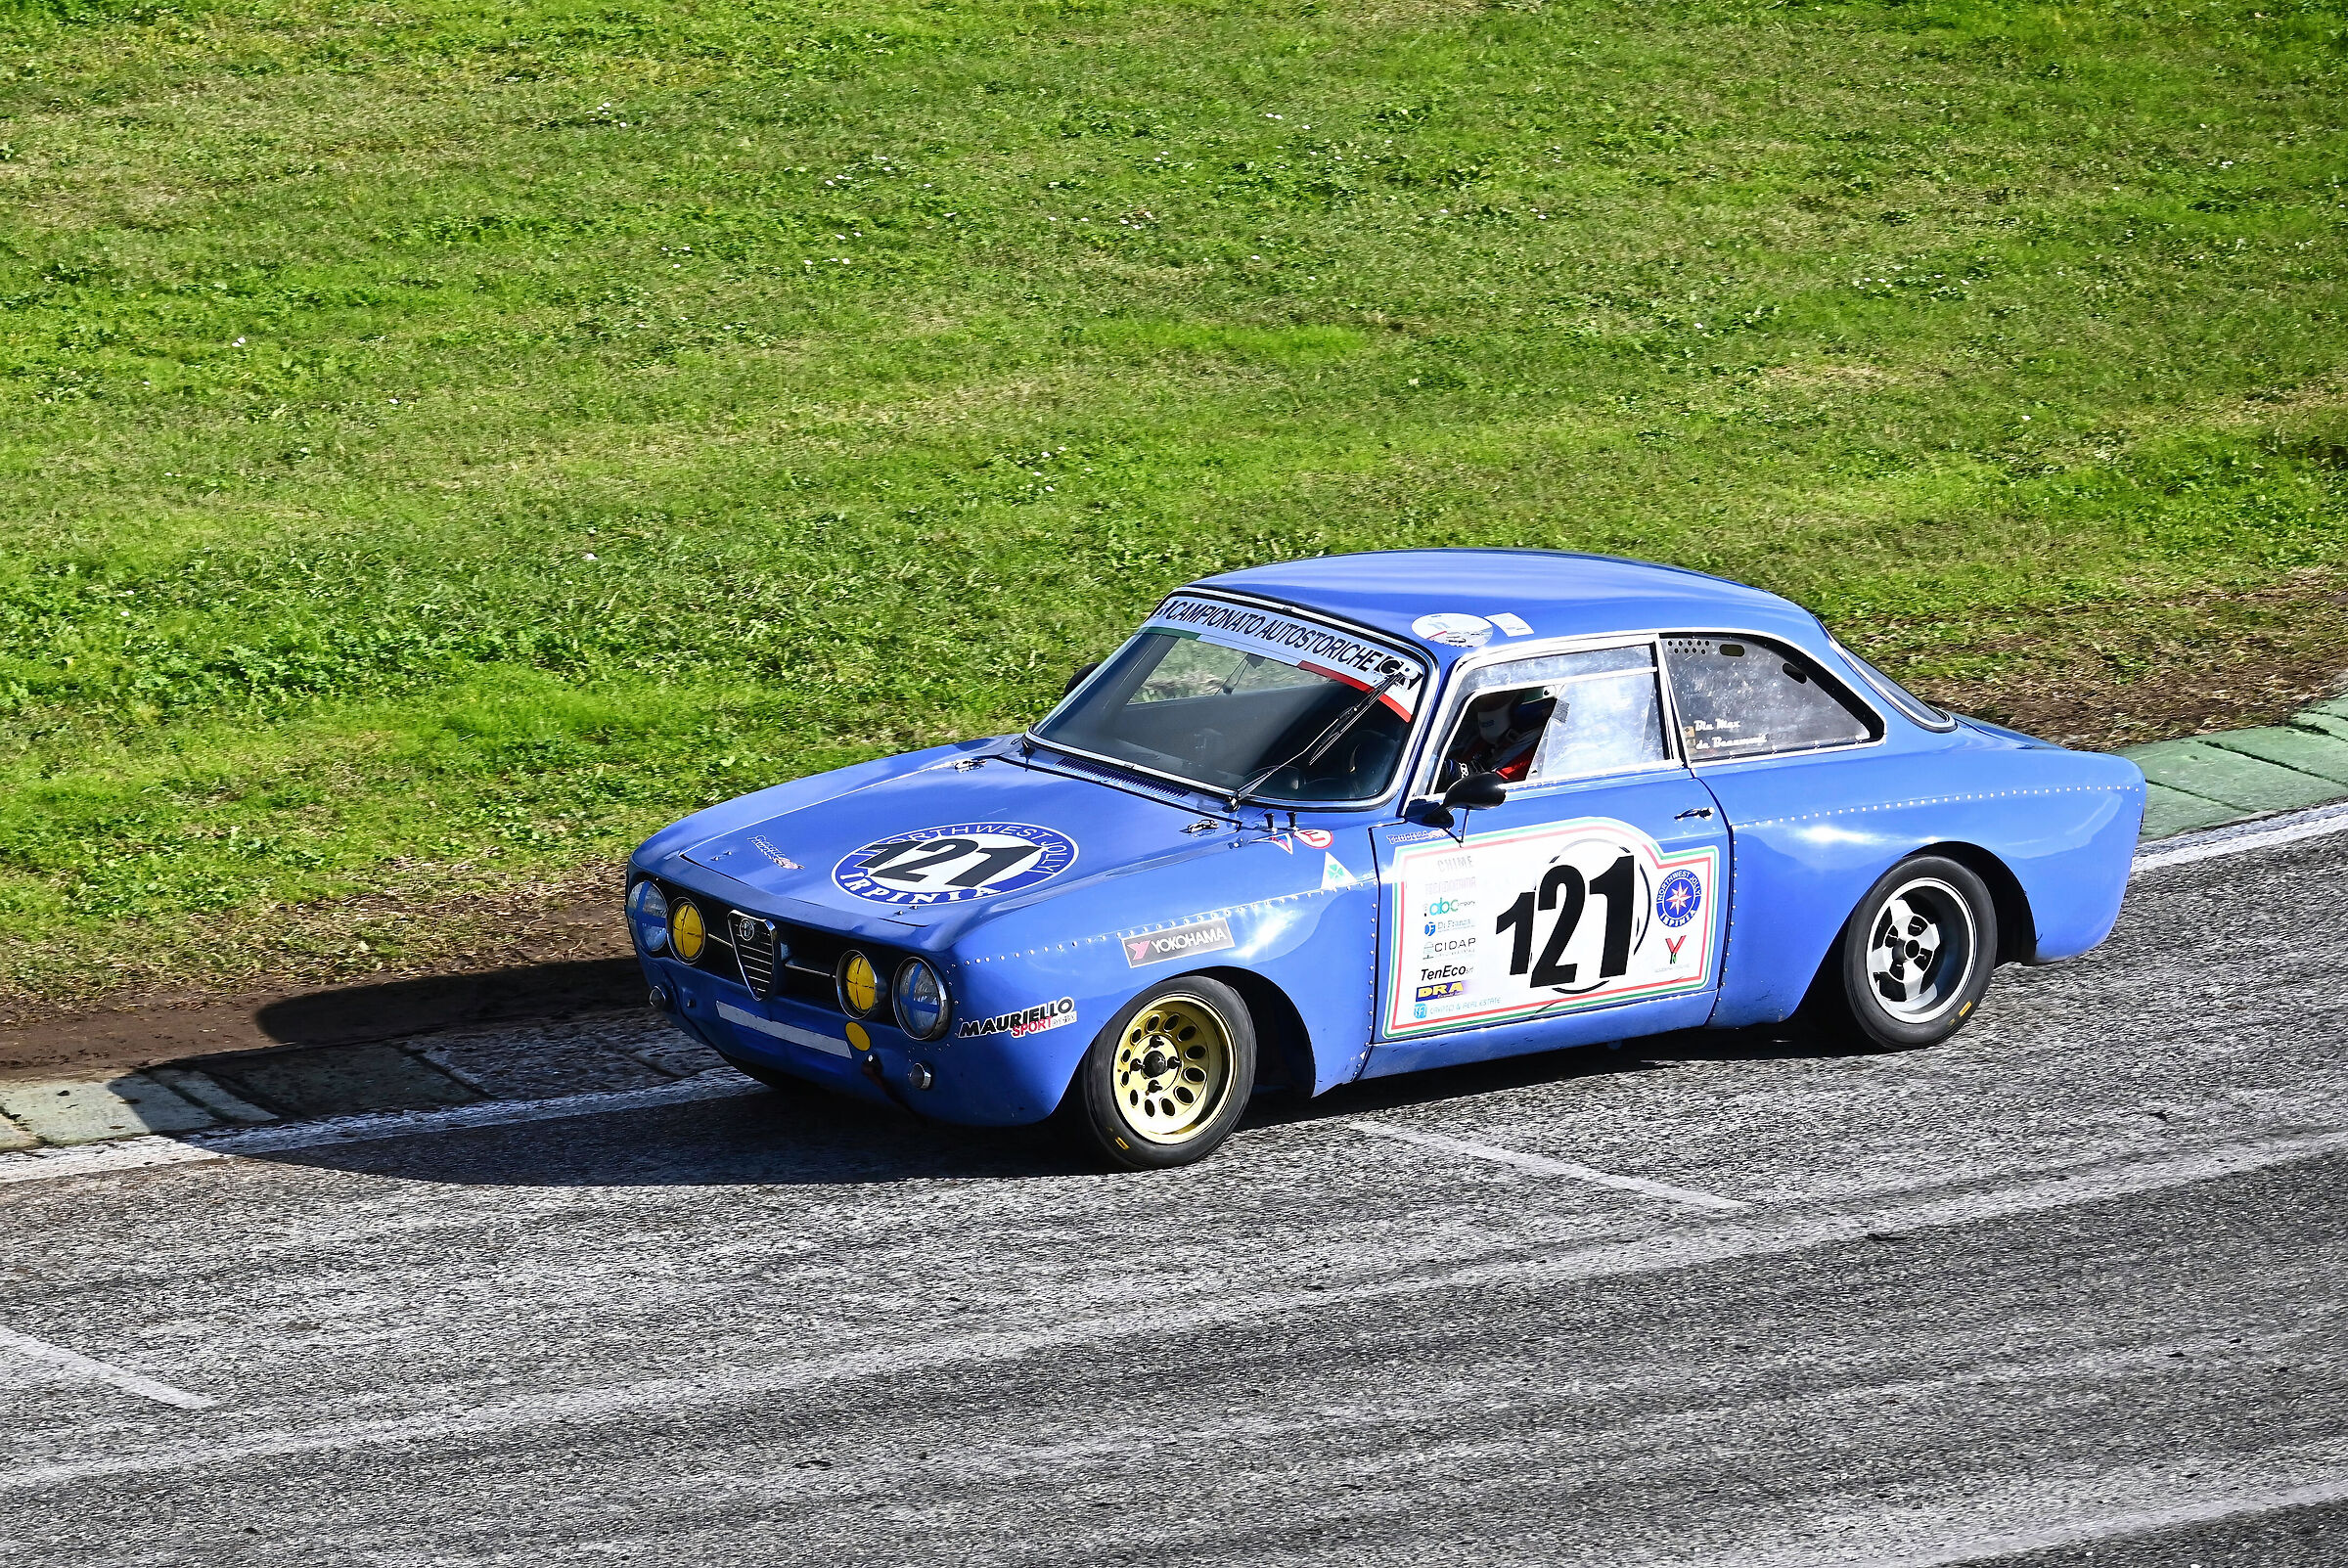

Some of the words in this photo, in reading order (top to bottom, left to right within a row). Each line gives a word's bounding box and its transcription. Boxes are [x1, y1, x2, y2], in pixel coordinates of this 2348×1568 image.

[1166, 601, 1267, 635] CAMPIONATO
[1257, 620, 1382, 672] AUTOSTORICHE
[854, 838, 1044, 888] 121
[1041, 839, 1068, 873] JOLLY
[840, 873, 1001, 904] IRPINIA
[1657, 870, 1691, 901] NORTHWEST
[1496, 855, 1635, 988] 121
[1151, 927, 1227, 955] YOKOHAMA
[1421, 964, 1466, 981] TenEco
[1418, 981, 1464, 998] DRA
[960, 997, 1073, 1037] MAURIELLO
[1013, 1016, 1053, 1037] SPORT
